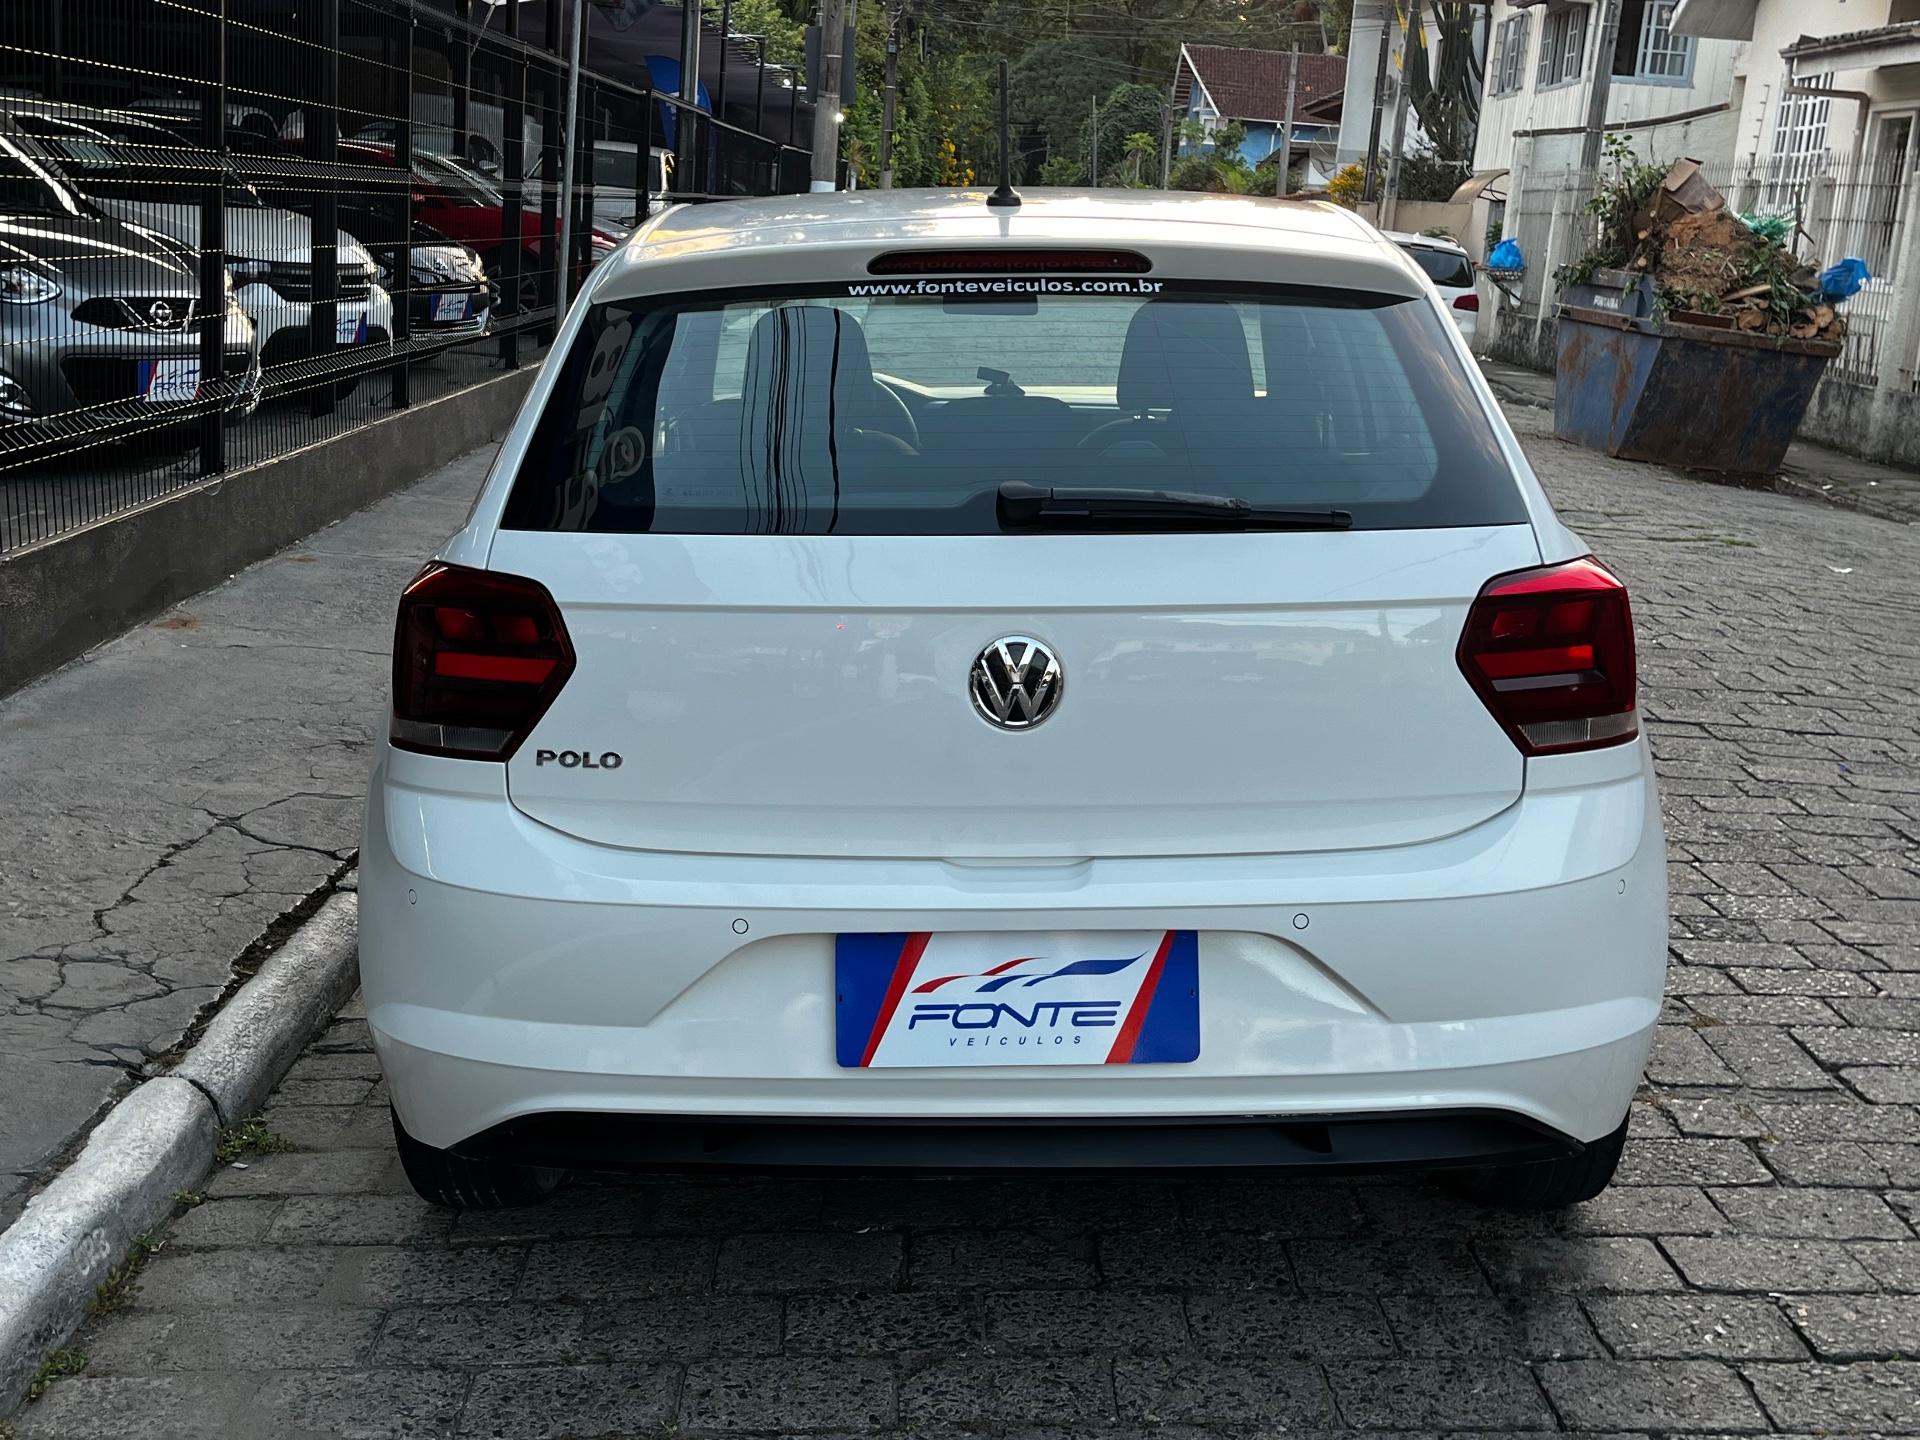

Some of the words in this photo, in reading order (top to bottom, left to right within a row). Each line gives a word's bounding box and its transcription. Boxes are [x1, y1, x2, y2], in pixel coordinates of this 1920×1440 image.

[848, 278, 1163, 296] www.fonteveiculos.com.br
[536, 749, 623, 769] POLO
[908, 1001, 1121, 1030] FONTE
[950, 1035, 1081, 1047] VEÍCULOS
